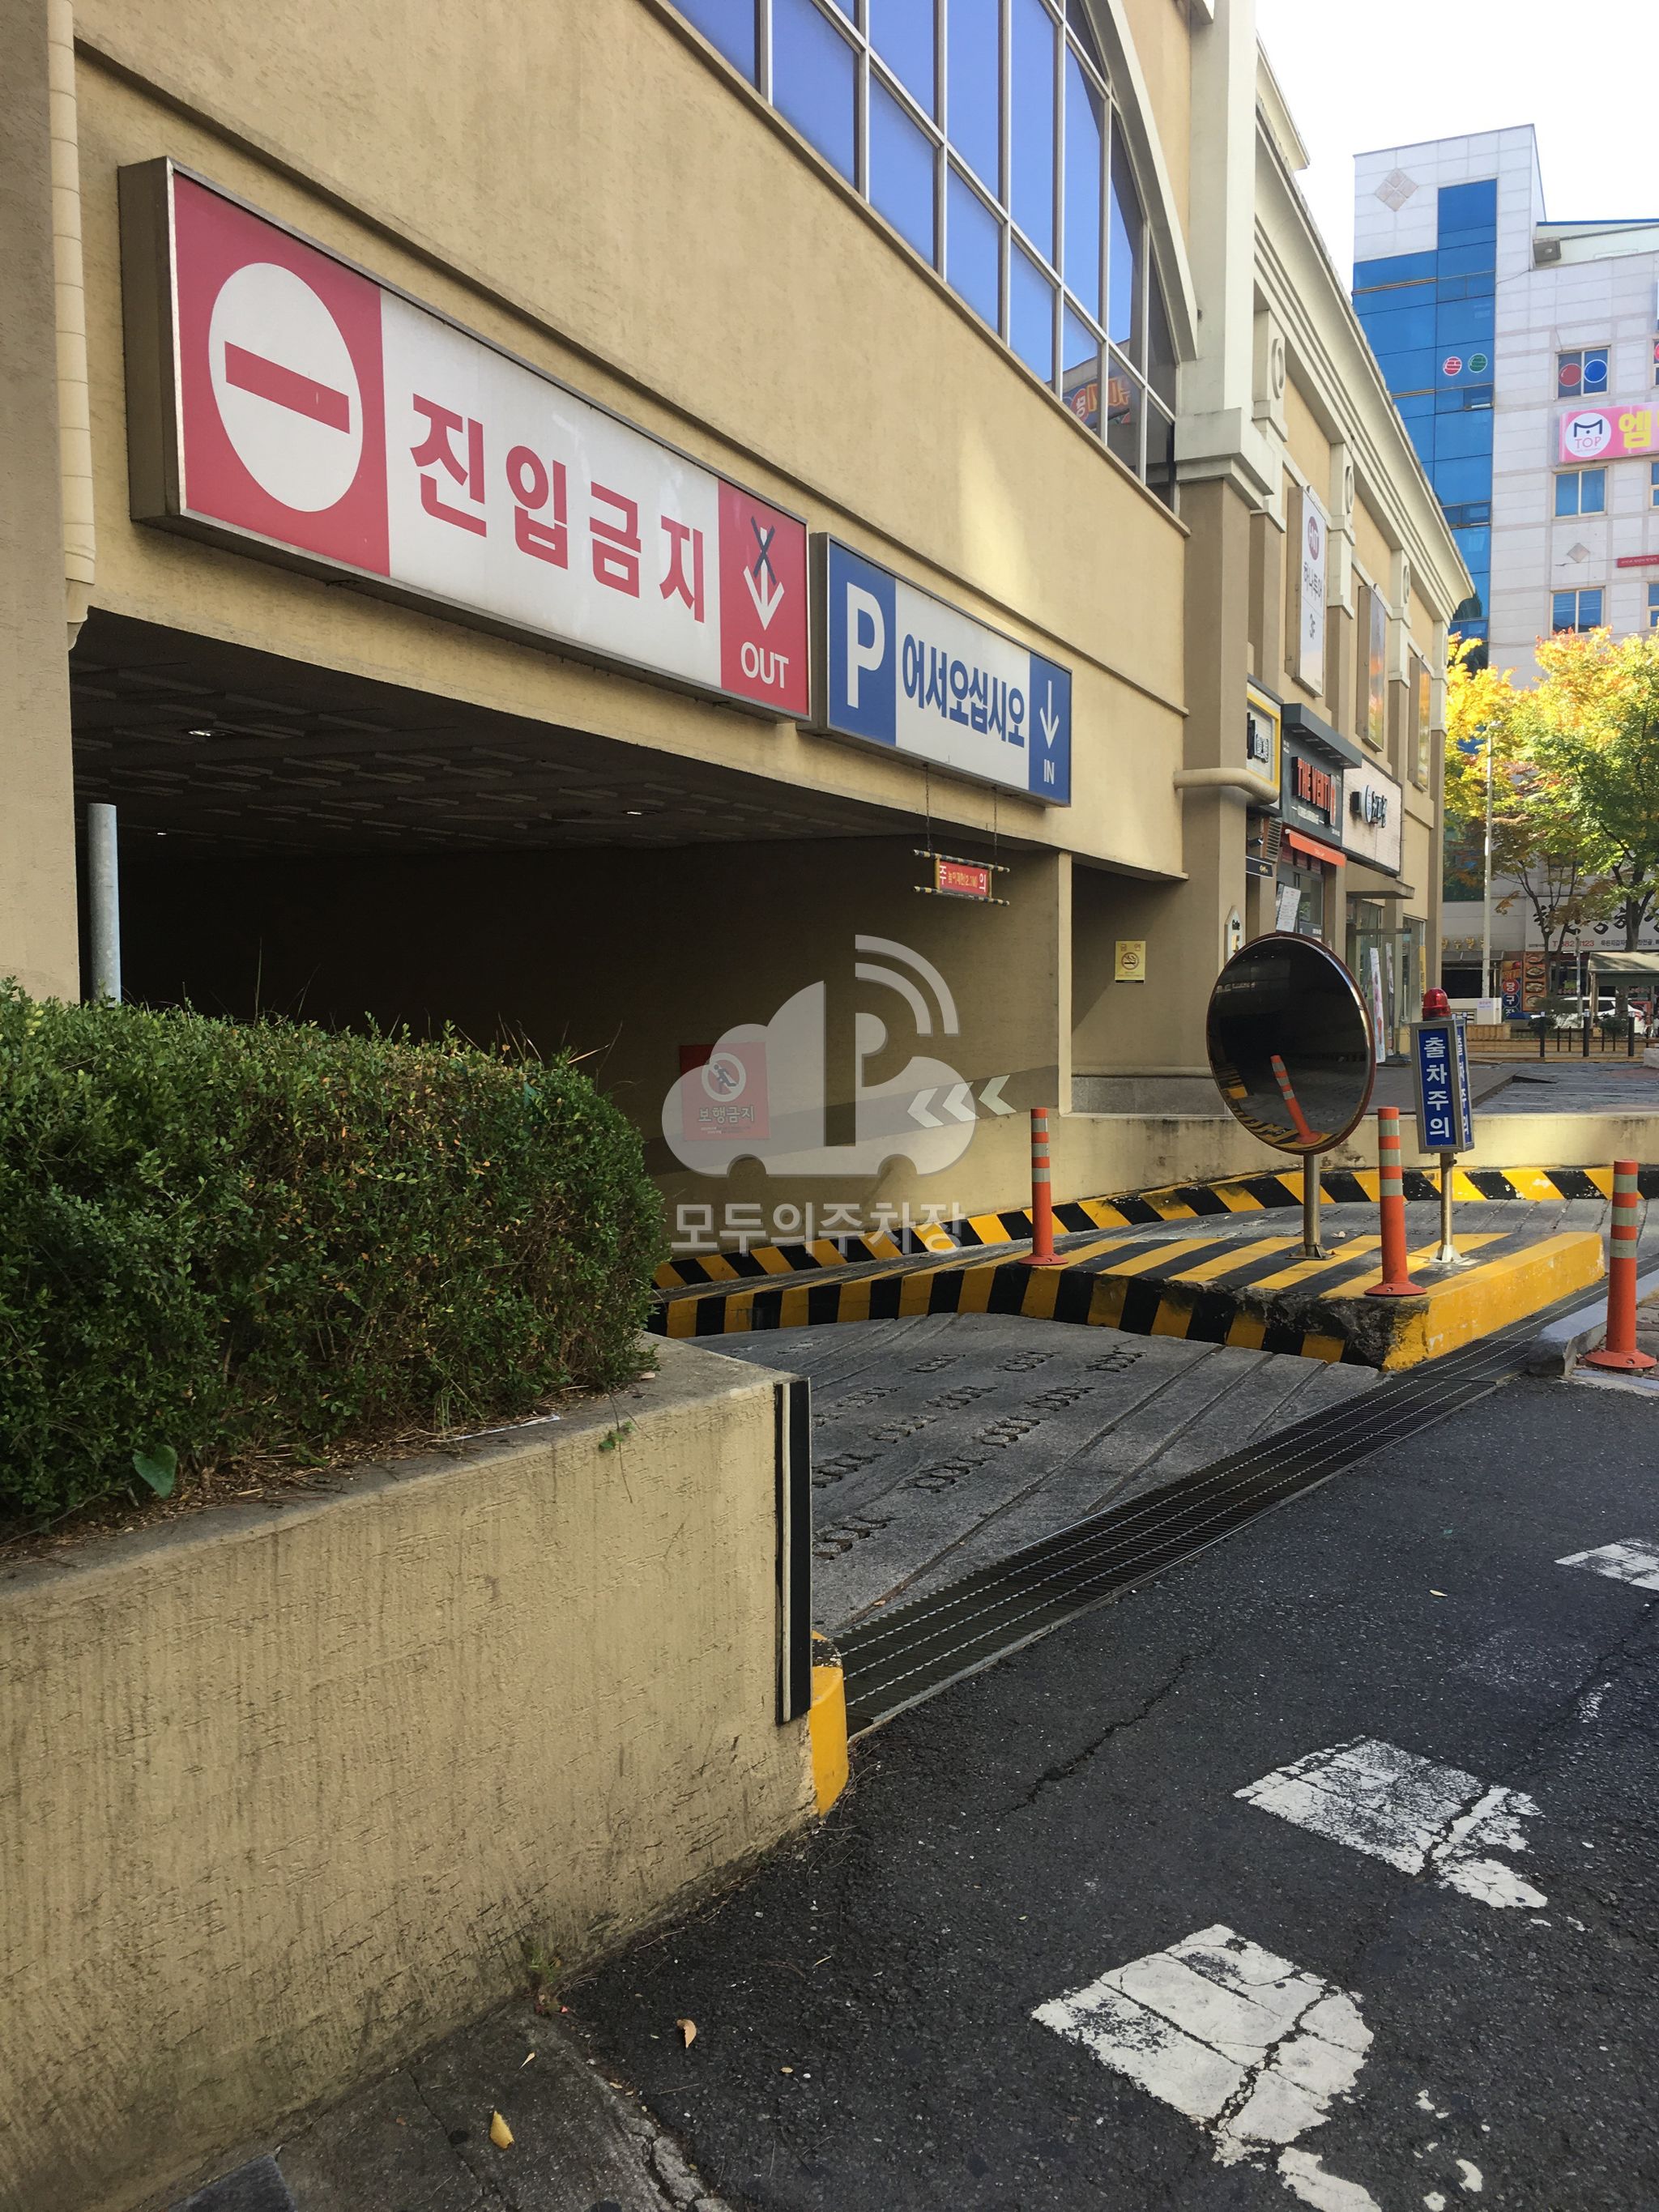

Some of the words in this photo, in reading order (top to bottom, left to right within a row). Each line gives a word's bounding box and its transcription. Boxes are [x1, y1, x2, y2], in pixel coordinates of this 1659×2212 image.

[1575, 437, 1601, 449] TOP
[1618, 410, 1659, 449] 엠
[410, 393, 705, 624] 진입금지
[740, 641, 790, 689] OUT
[847, 582, 885, 709] P
[902, 633, 1026, 749] 어서오십시오
[1043, 761, 1055, 785] IN
[1423, 1037, 1450, 1138] 출차주의
[697, 1105, 754, 1124] 보행금지
